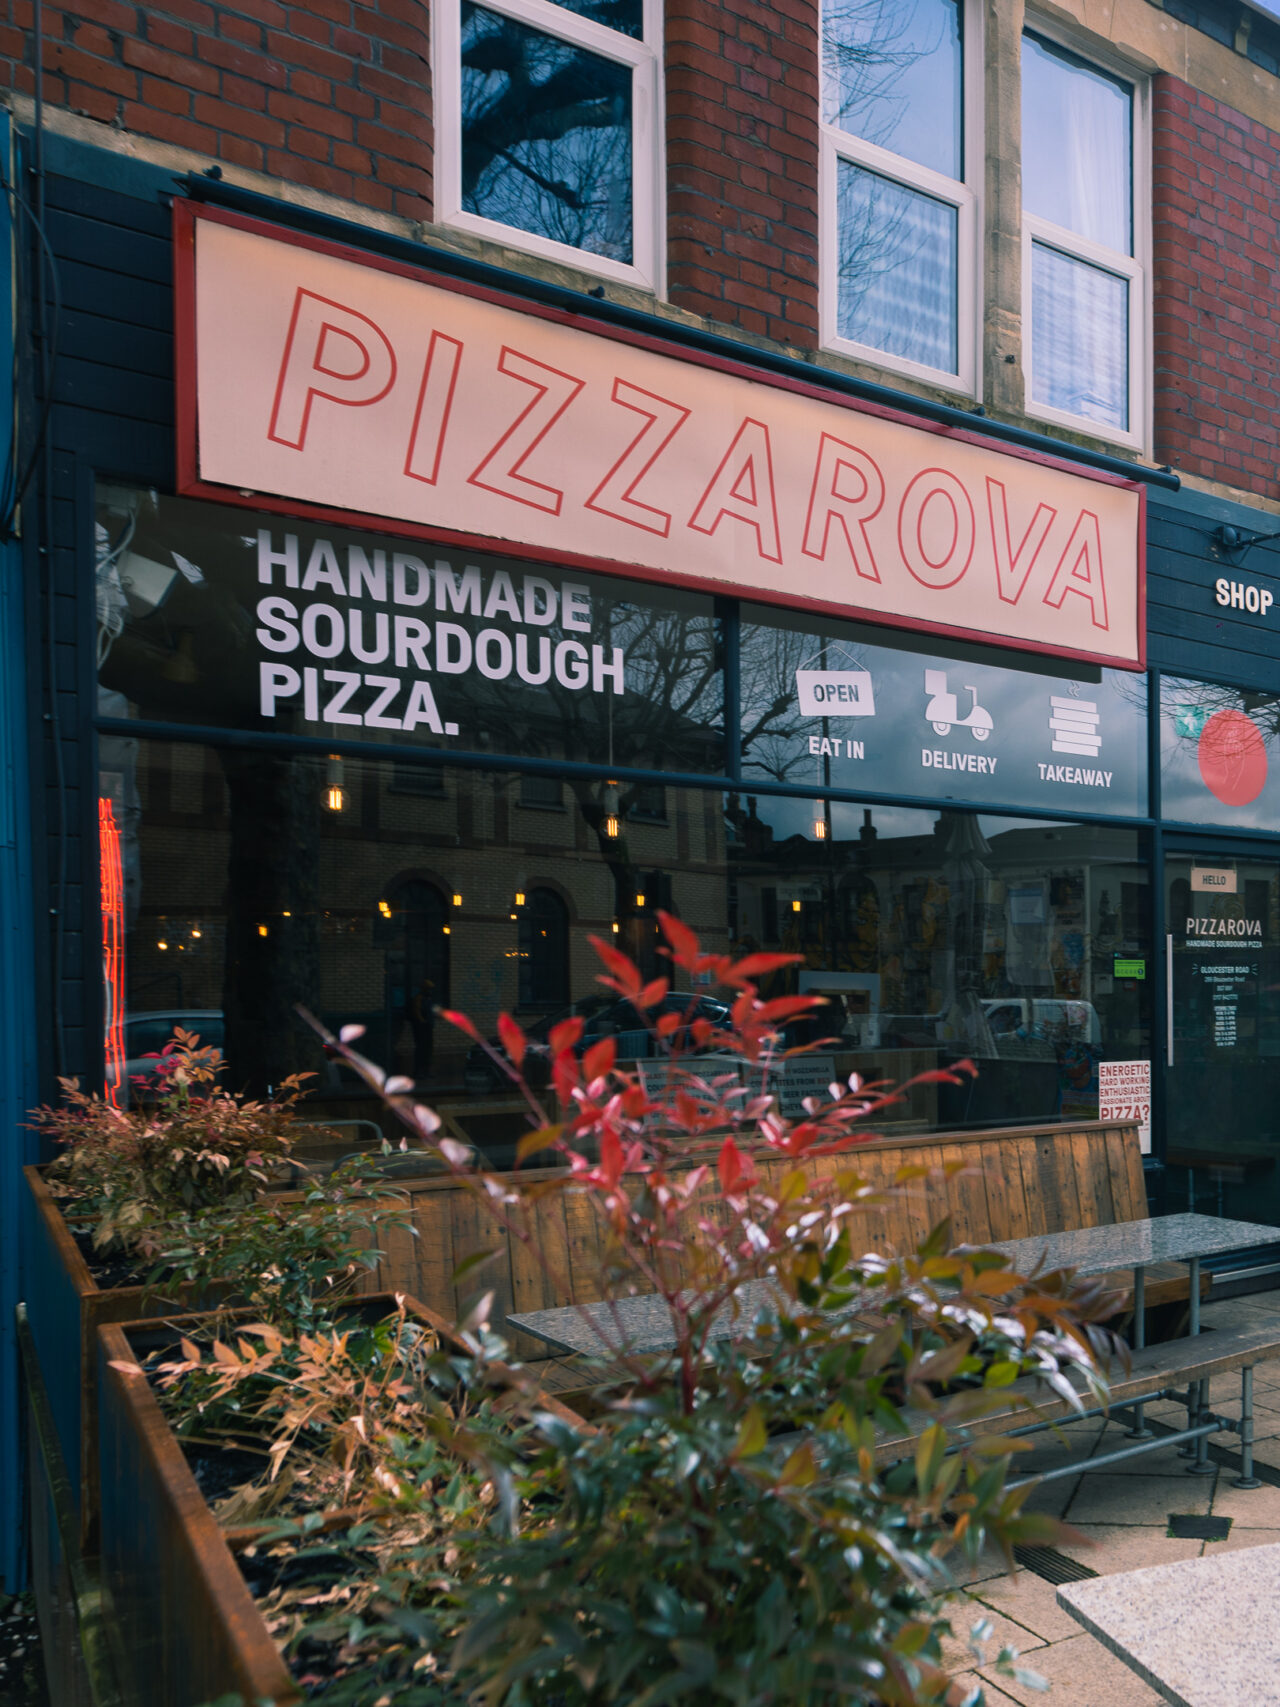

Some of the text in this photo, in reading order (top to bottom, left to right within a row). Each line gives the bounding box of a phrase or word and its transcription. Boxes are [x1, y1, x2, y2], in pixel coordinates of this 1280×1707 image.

[267, 286, 1109, 631] PIZZAROVA
[256, 529, 593, 633] HANDMADE
[1215, 578, 1273, 616] SHOP
[255, 596, 625, 695] SOURDOUGH
[258, 661, 460, 736] PIZZA.
[812, 682, 859, 704] OPEN
[808, 735, 865, 760] EAT IN
[921, 749, 998, 775] DELIVERY
[1037, 763, 1113, 788] TAKEAWAY
[1202, 874, 1227, 886] HELLO
[1186, 917, 1262, 937] PIZZAROVA
[1186, 940, 1263, 949] HANDMADE SOURDOUGH PIZZA
[1200, 966, 1250, 974] GLOUCESTER ROAD
[1100, 1064, 1150, 1078] ENERGETIC
[1100, 1076, 1150, 1087] HARD WORKING
[1100, 1085, 1151, 1097] ENTHUSIASTIC
[1100, 1096, 1151, 1105] PASSIONATE ABOUT
[1101, 1104, 1150, 1121] PIZZA?
